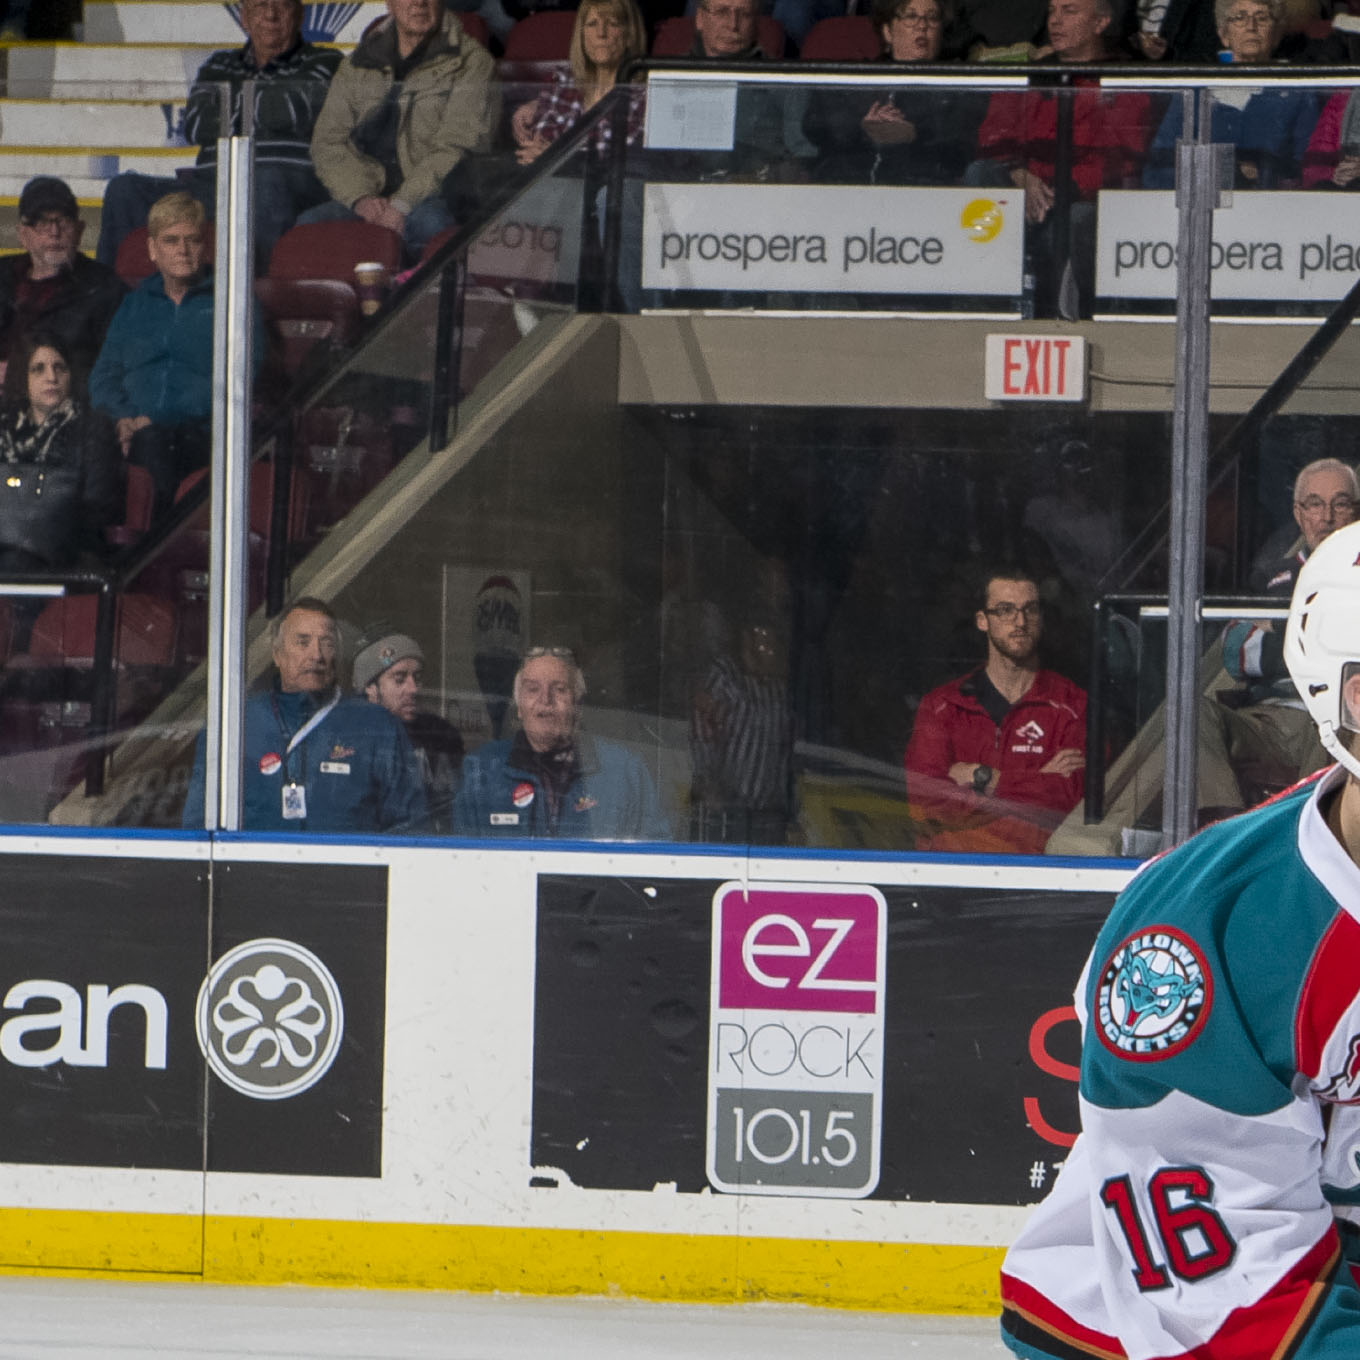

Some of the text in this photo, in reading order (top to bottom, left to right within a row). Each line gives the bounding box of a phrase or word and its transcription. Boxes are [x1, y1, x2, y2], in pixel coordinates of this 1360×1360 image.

[661, 226, 944, 271] prospera place
[1114, 237, 1284, 276] propera
[1003, 338, 1071, 397] EXIT
[741, 914, 878, 992] ez
[2, 980, 169, 1070] an
[716, 1022, 875, 1080] ROCK
[733, 1106, 858, 1167] 101.5
[1100, 1165, 1238, 1293] 16
